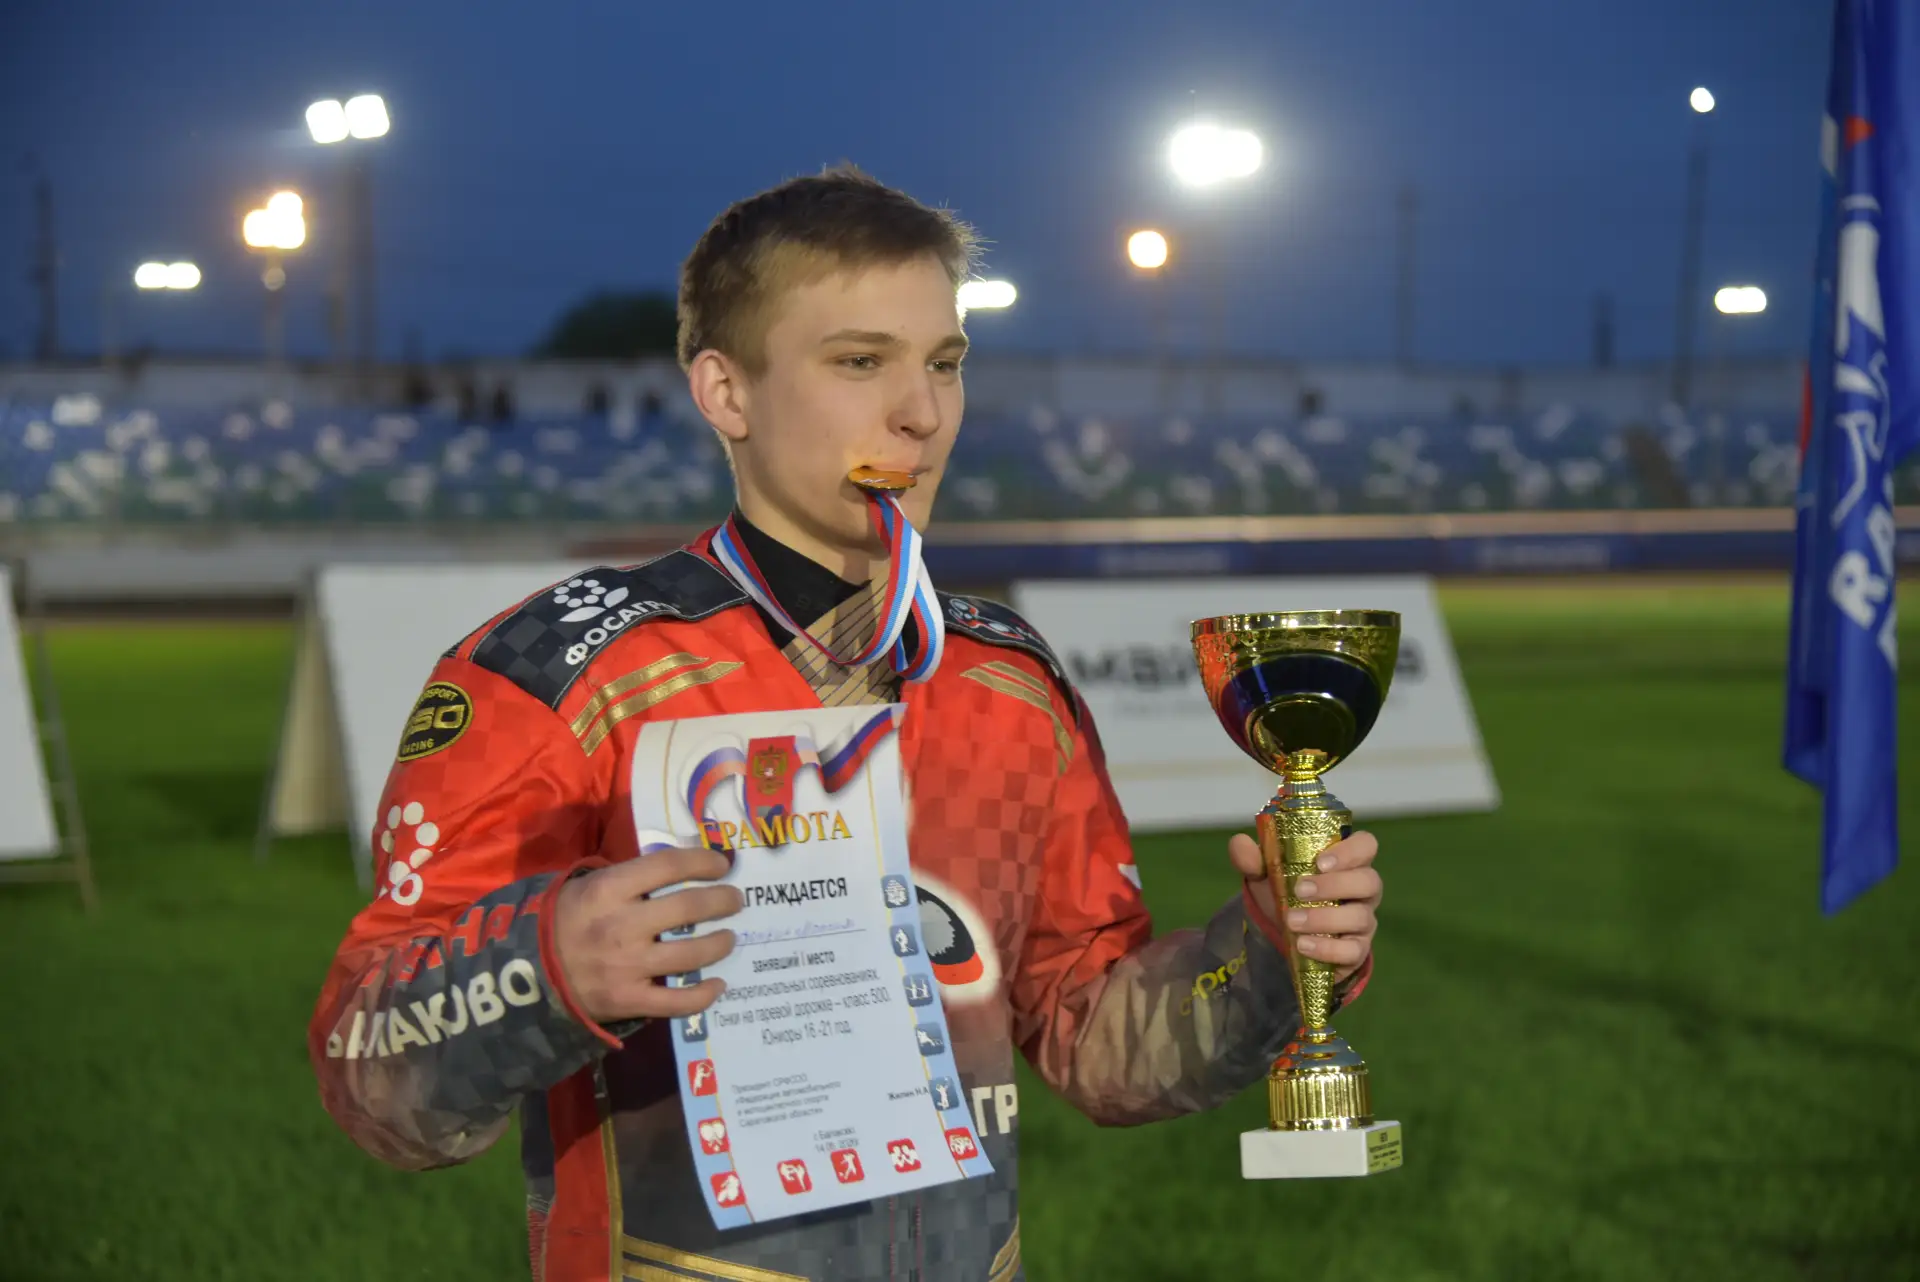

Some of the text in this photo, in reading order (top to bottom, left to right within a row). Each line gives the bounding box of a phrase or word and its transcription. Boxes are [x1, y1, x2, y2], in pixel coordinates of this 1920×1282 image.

[565, 600, 668, 665] ФОСАГР
[699, 810, 853, 852] ГРАМОТА
[744, 877, 848, 908] ГРАЖДАЕТСЯ
[806, 950, 836, 966] место
[713, 1009, 740, 1028] Гонки
[743, 1010, 754, 1024] на
